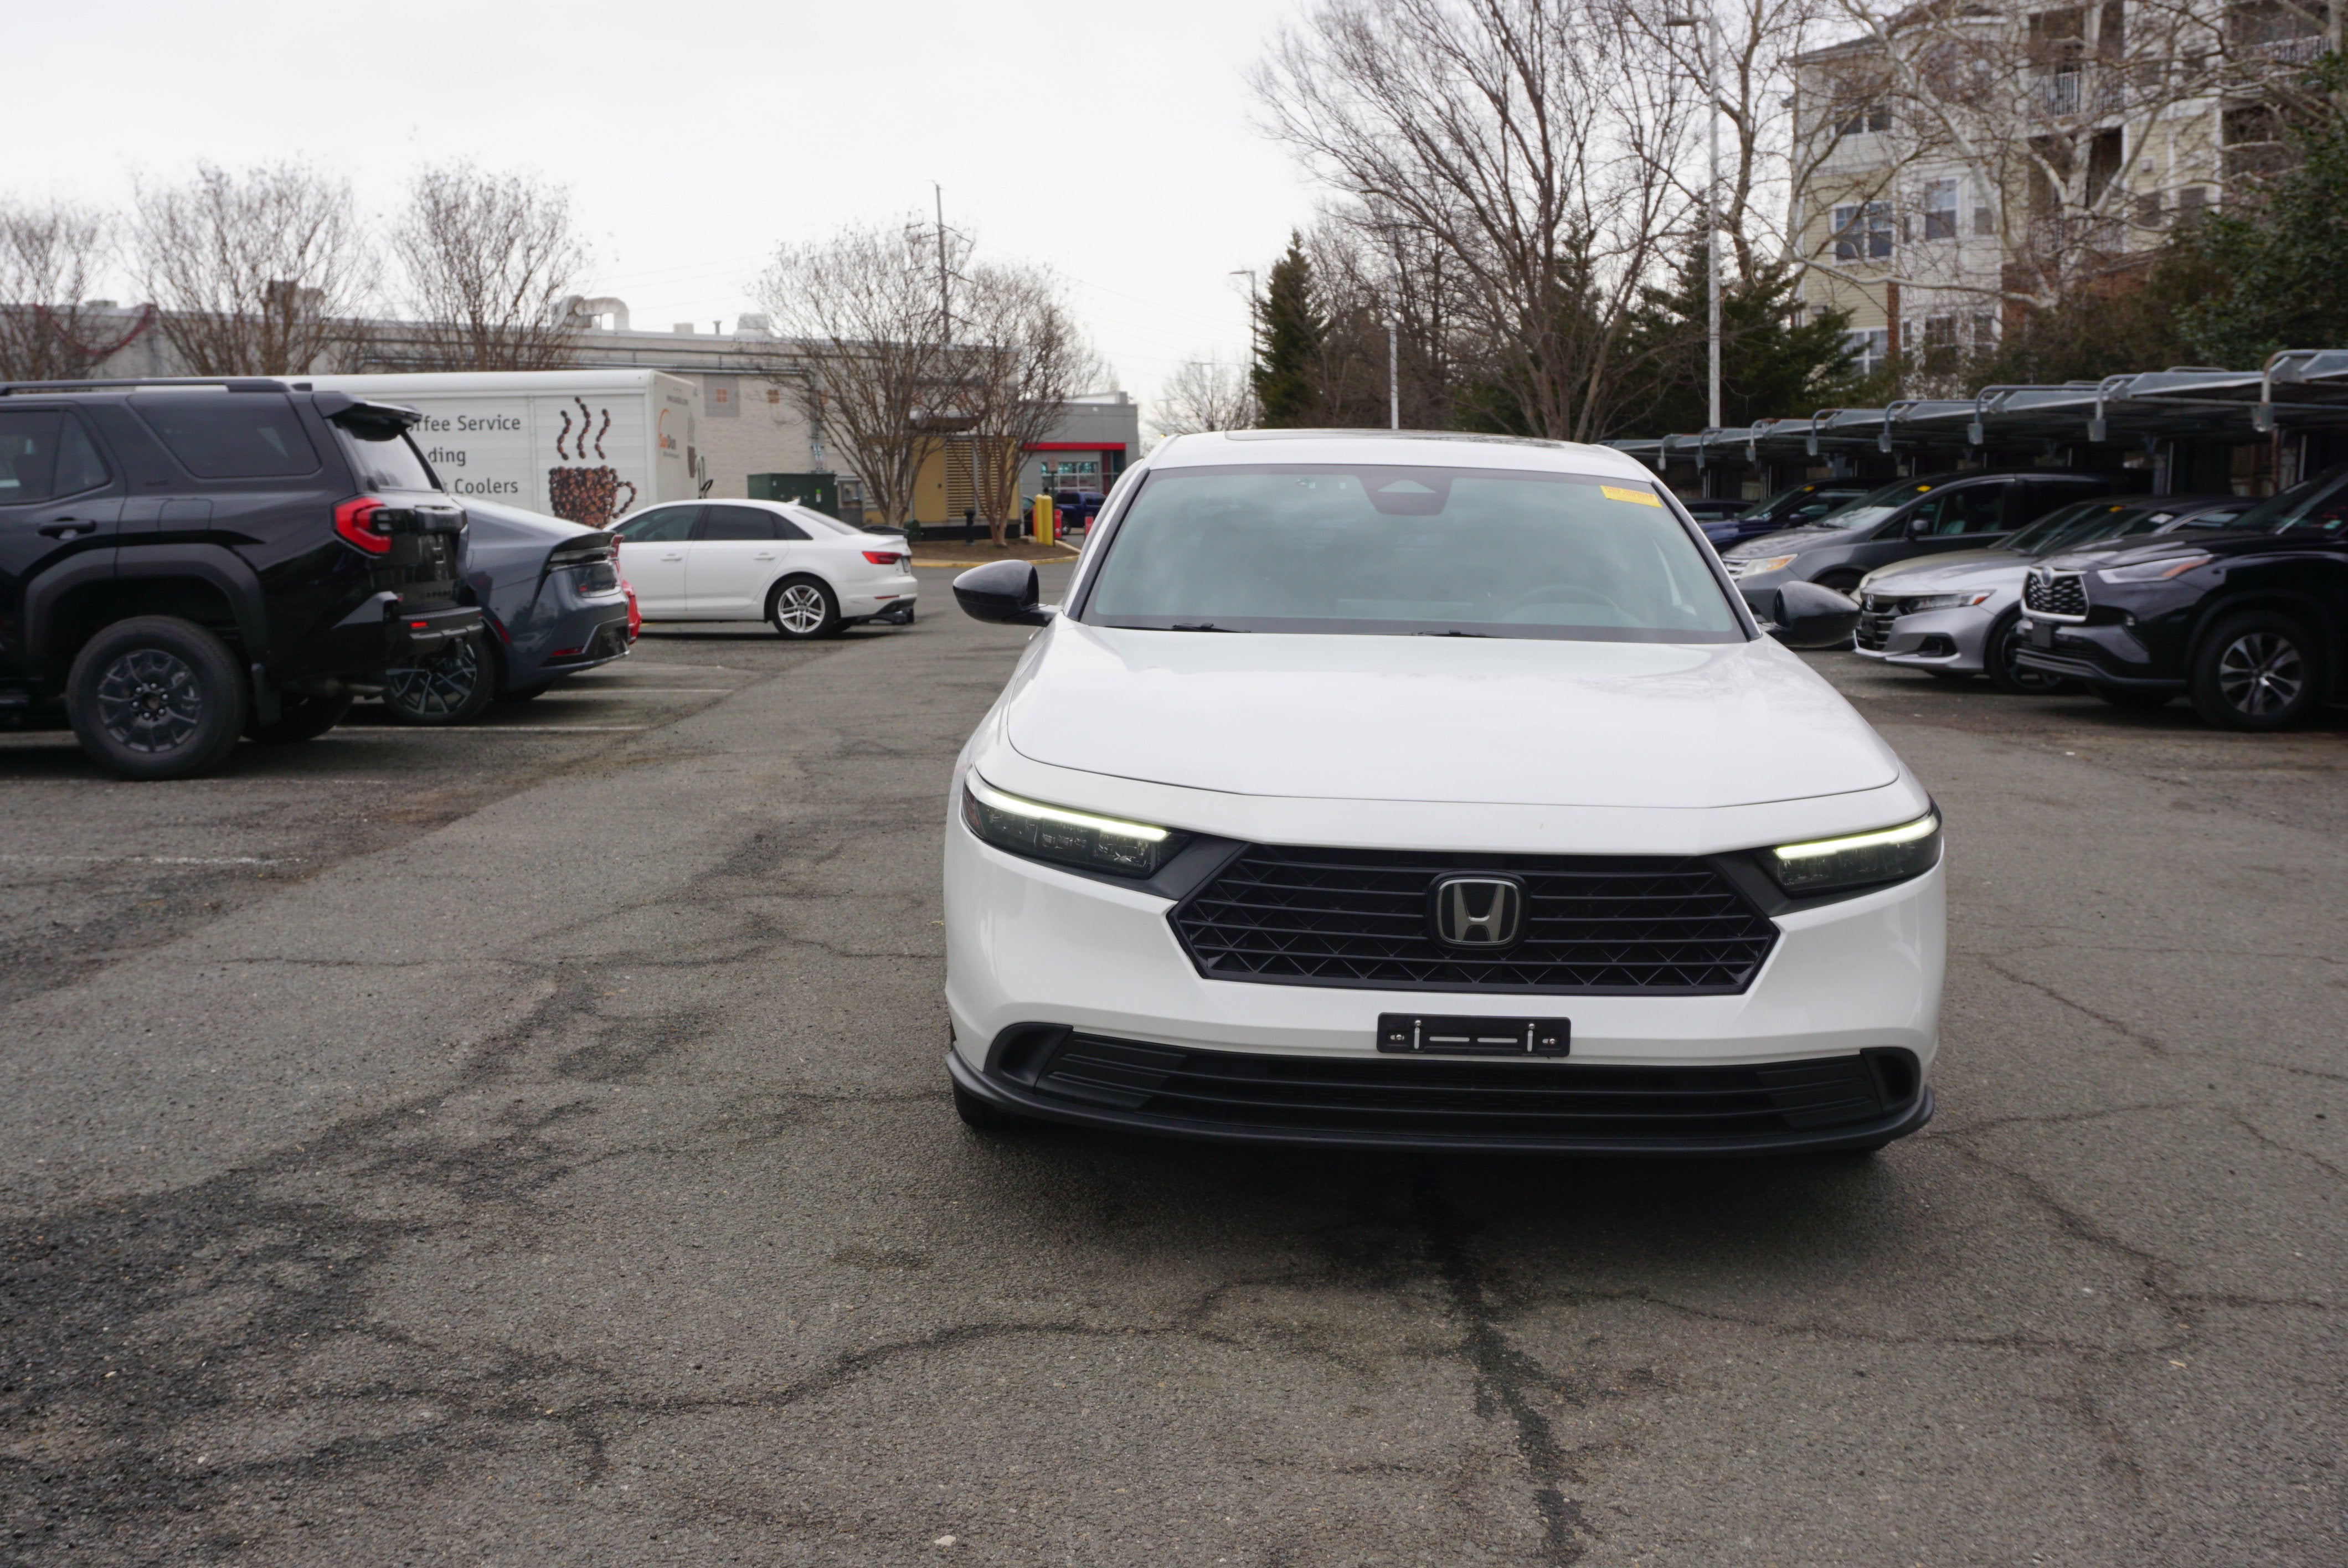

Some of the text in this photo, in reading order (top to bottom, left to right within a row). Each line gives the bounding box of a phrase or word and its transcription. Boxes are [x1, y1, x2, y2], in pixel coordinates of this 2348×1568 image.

[457, 414, 521, 431] Service
[428, 447, 466, 467] ding
[455, 477, 518, 494] Coolers
